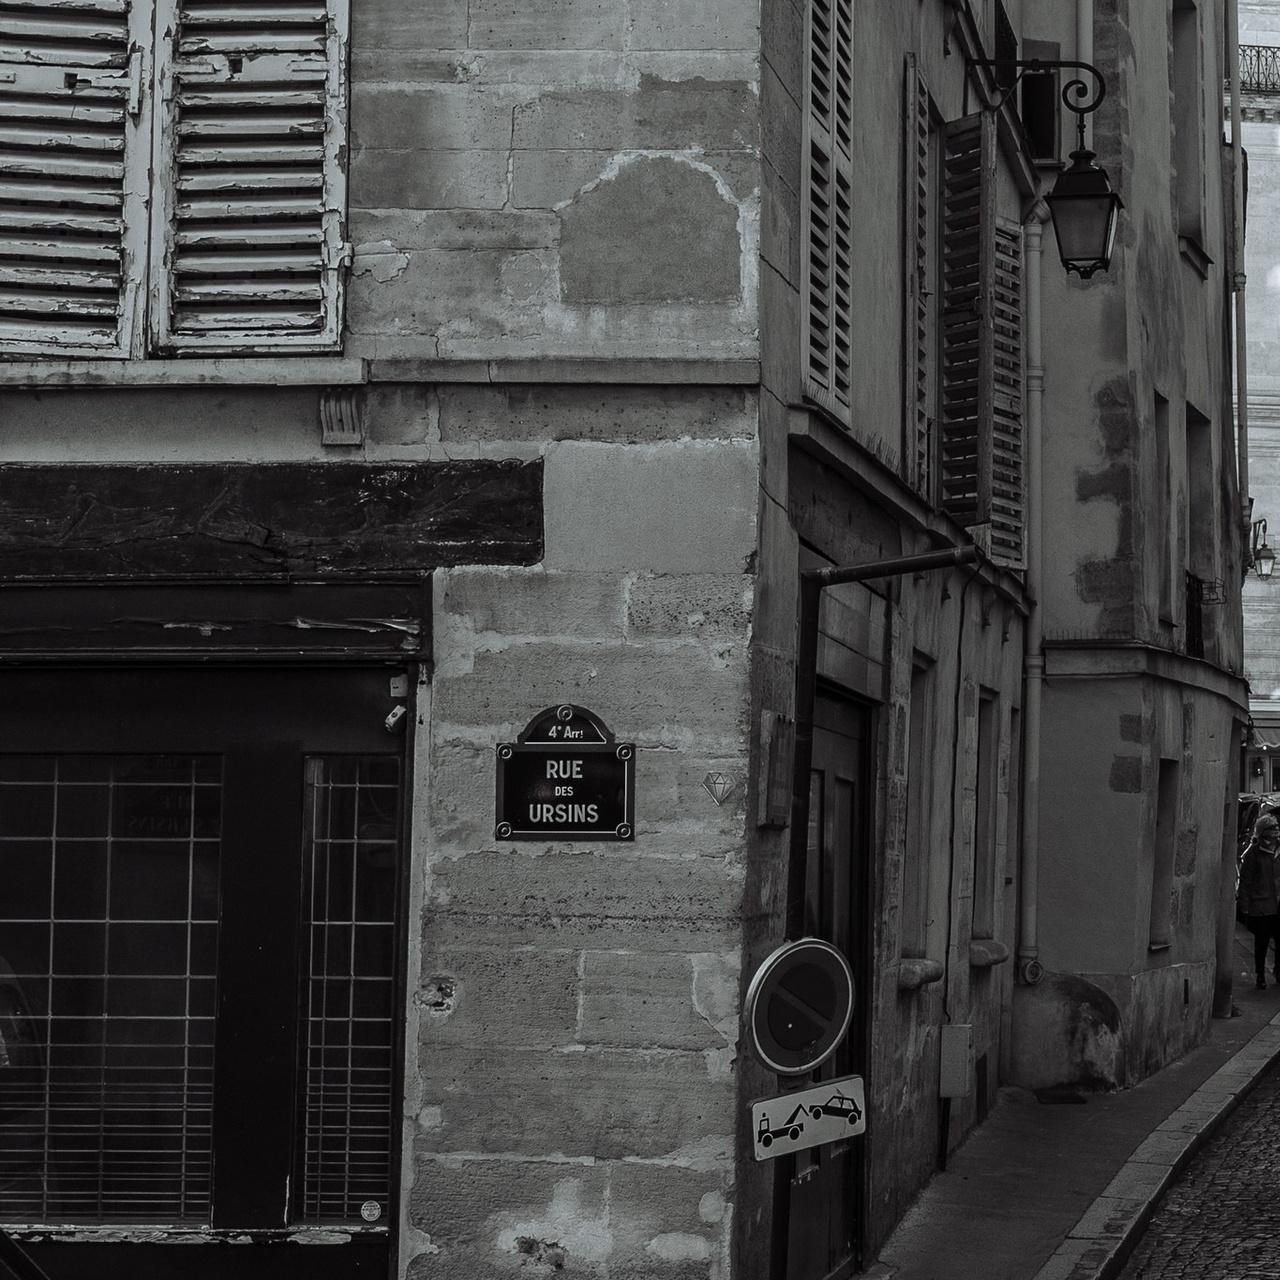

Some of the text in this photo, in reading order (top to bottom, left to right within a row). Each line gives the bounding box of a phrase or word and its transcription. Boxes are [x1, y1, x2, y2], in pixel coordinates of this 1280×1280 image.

[546, 760, 583, 779] RUE
[555, 786, 574, 797] DES
[529, 804, 599, 823] URSINS
